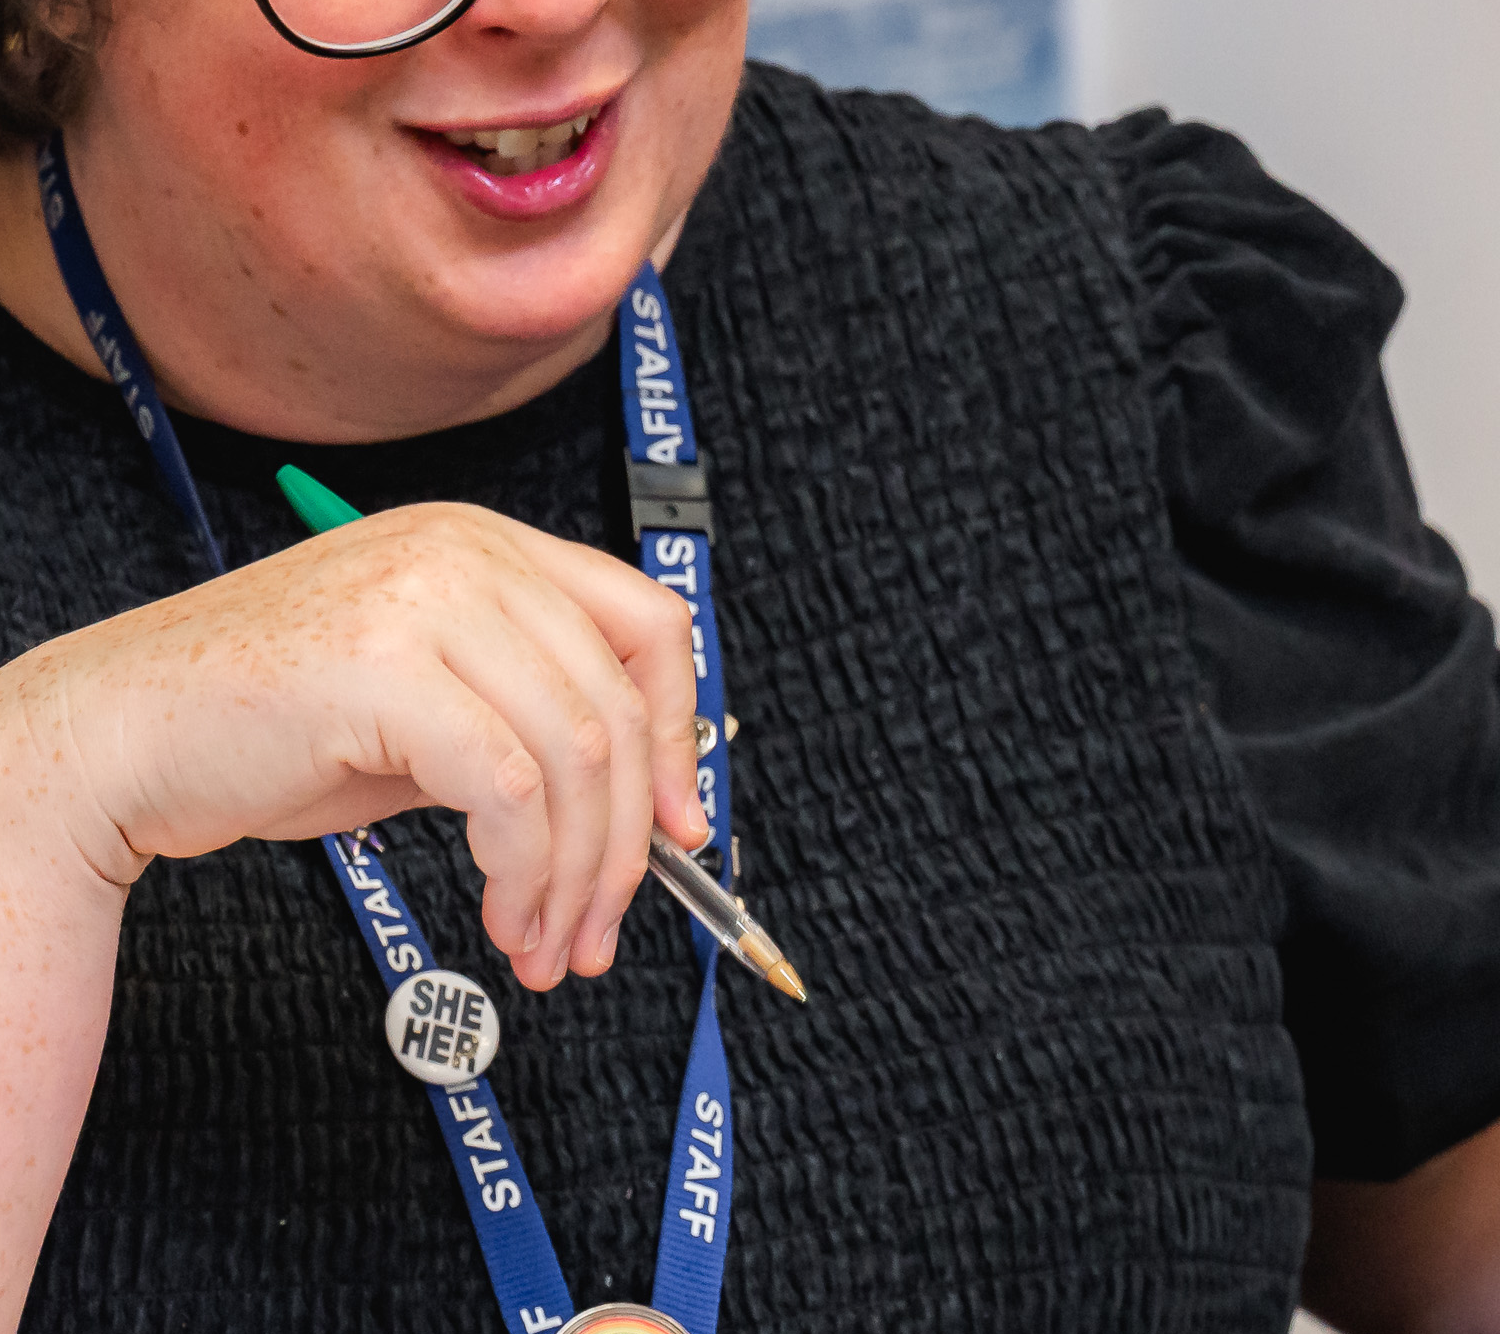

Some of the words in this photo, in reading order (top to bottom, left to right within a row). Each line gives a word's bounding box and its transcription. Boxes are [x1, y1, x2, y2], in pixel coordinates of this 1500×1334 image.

[85, 309, 155, 442] STAFF
[401, 1017, 481, 1073] HER
[409, 978, 486, 1030] SHE
[445, 1082, 523, 1213] STAF
[678, 1091, 725, 1244] STAFF
